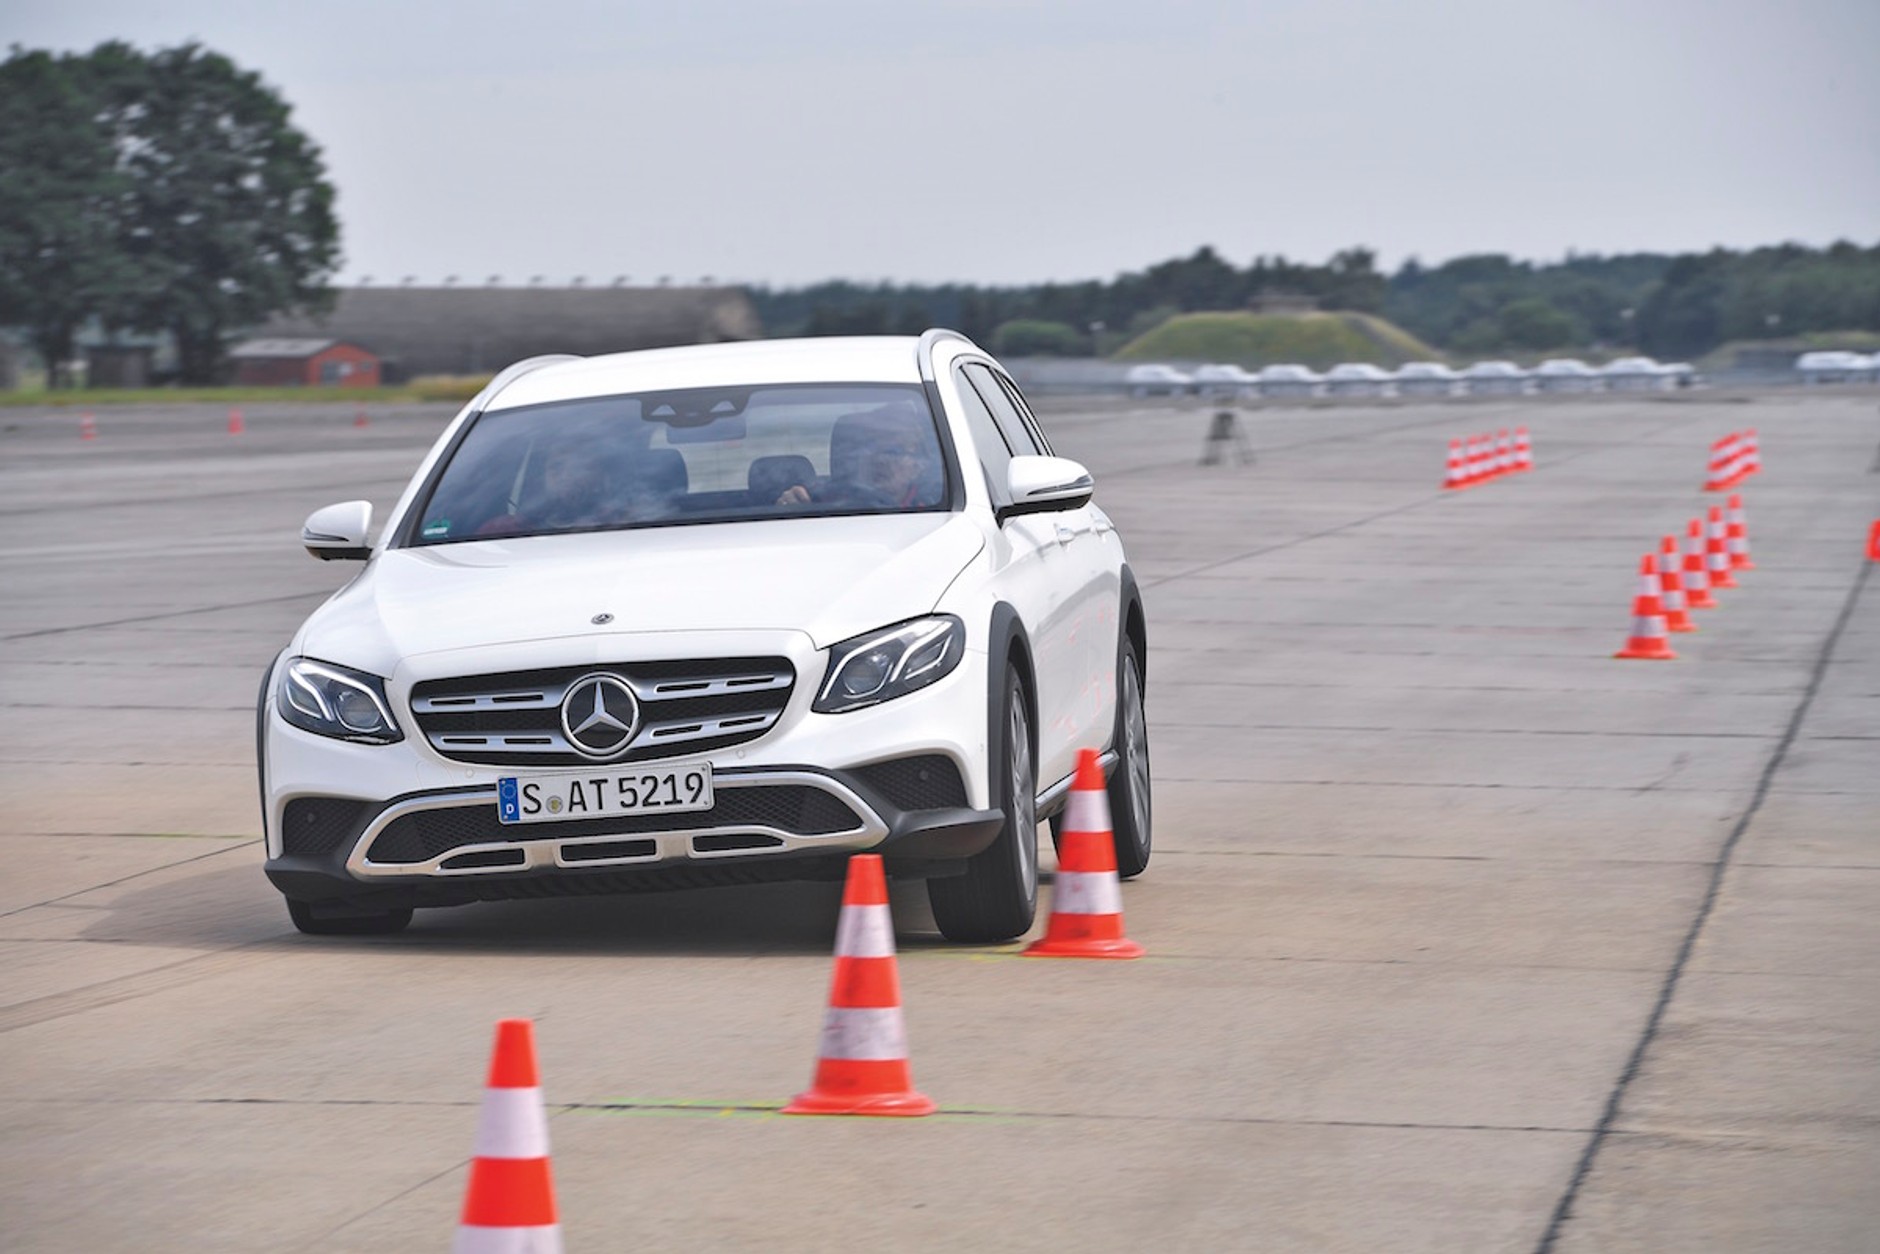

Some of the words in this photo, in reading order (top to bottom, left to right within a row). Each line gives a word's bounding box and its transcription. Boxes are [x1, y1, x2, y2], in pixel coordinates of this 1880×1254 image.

[522, 783, 542, 814] S
[568, 778, 608, 812] AT
[618, 772, 704, 808] 5219
